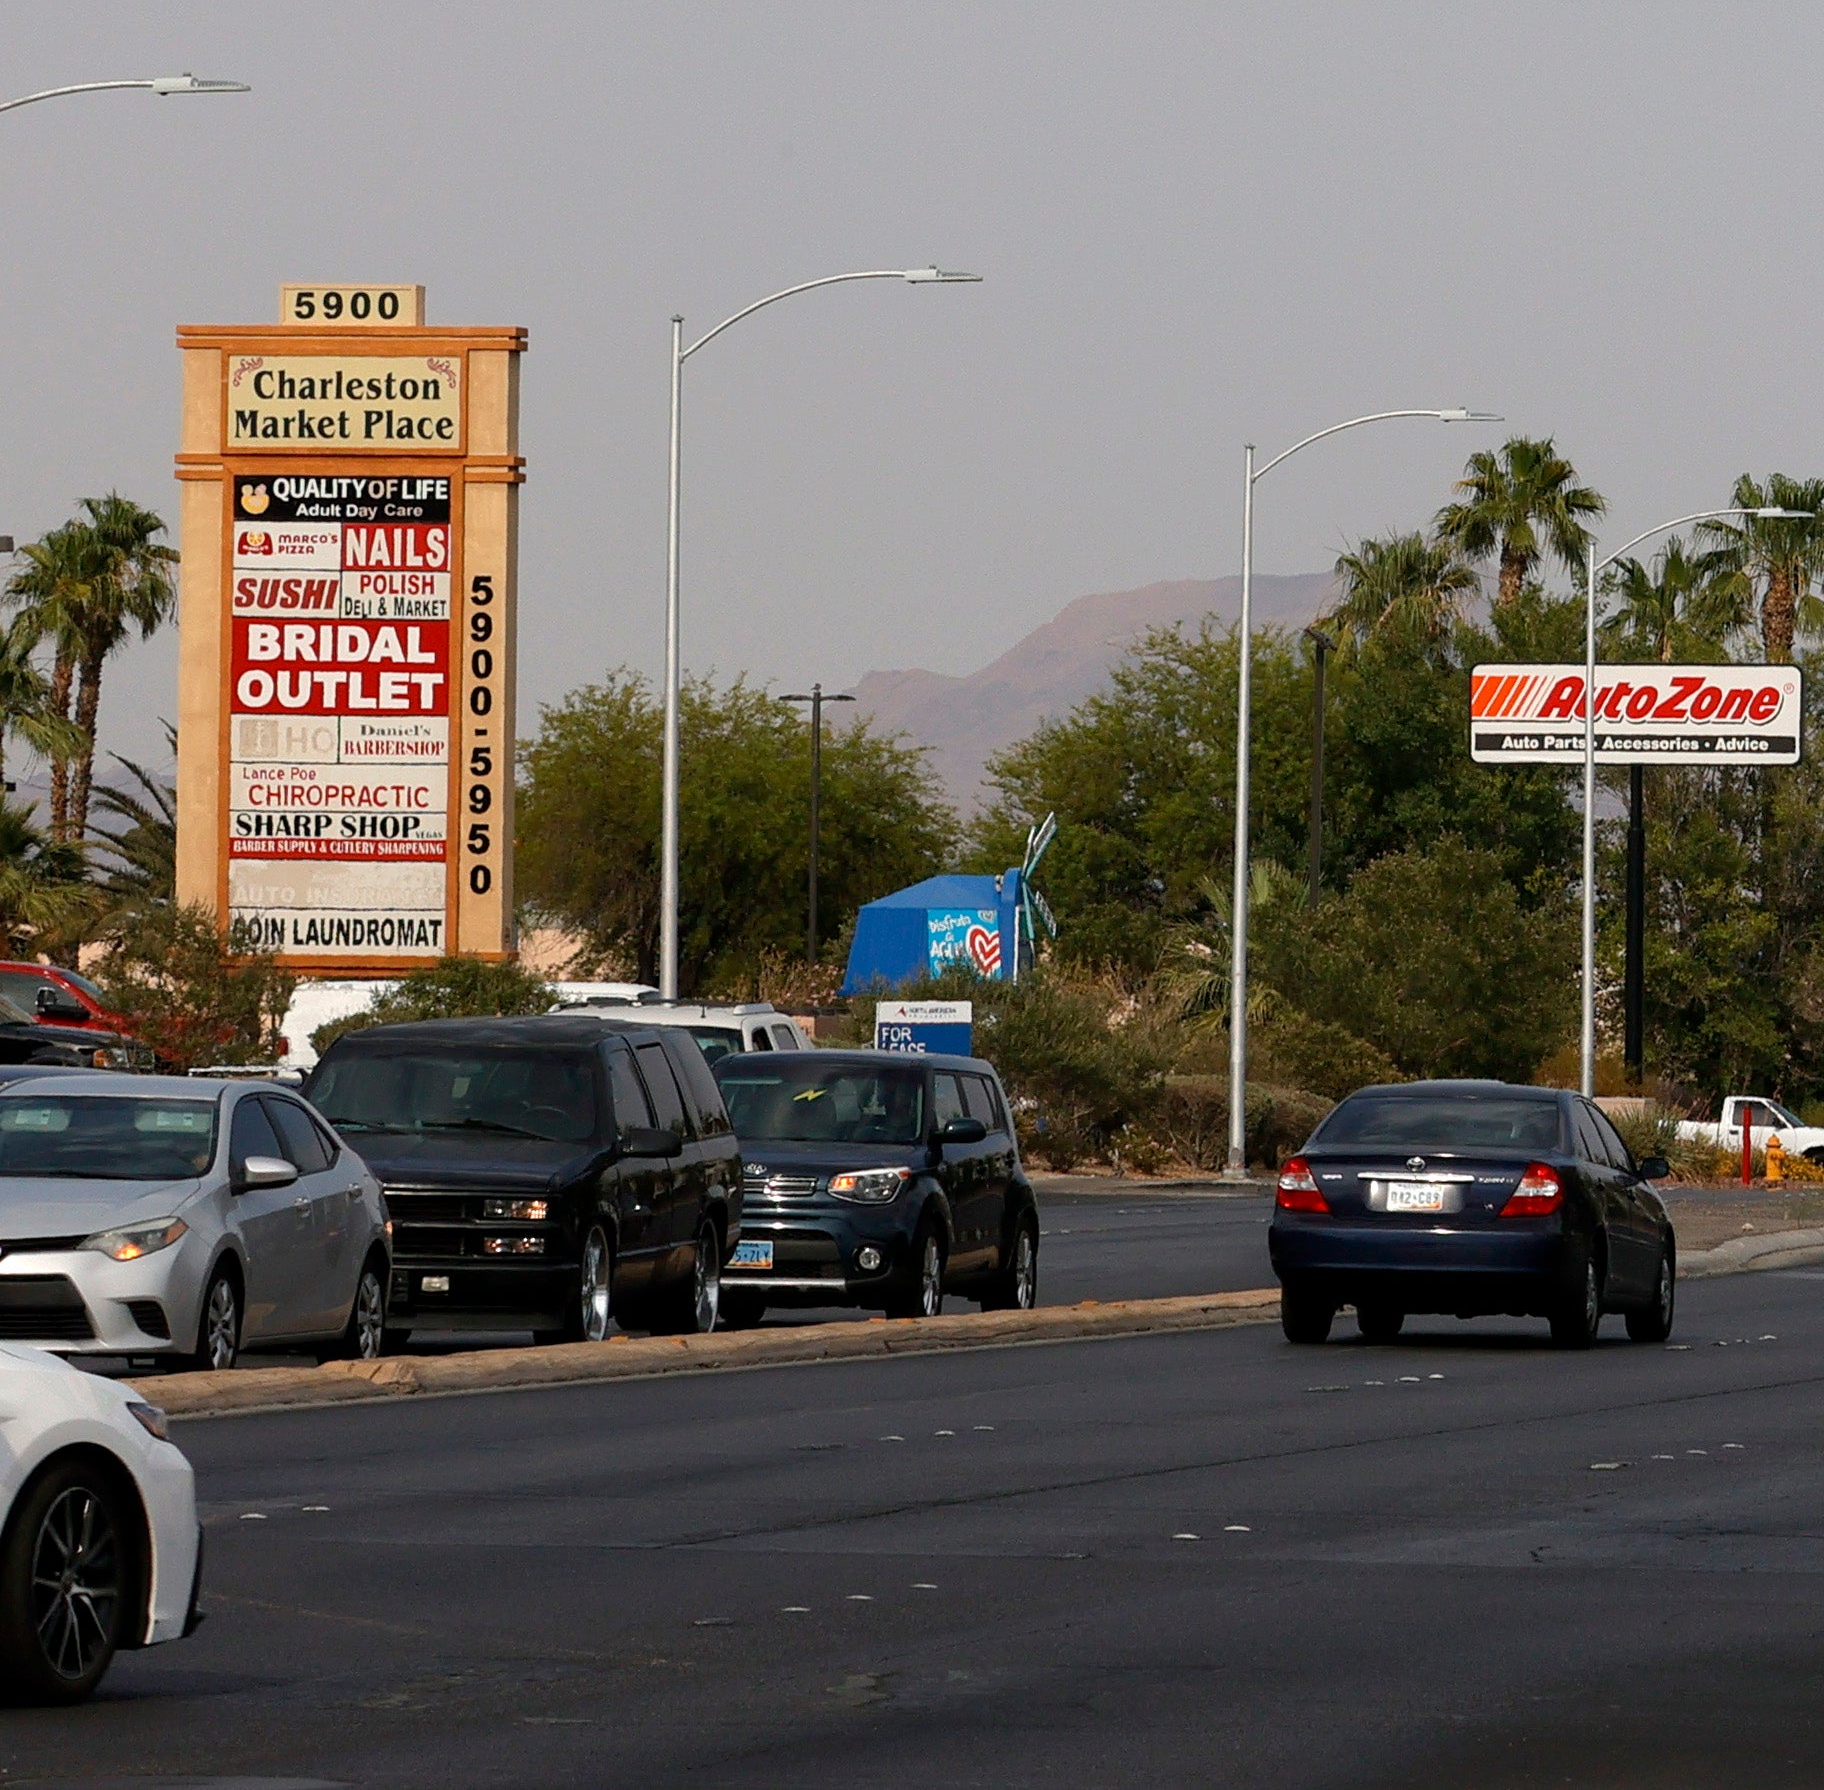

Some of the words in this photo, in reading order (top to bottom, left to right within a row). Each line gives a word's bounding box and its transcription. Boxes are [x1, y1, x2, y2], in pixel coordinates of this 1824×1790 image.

[295, 291, 400, 319] 5900
[253, 370, 441, 400] Charleston
[234, 409, 350, 439] Market
[364, 409, 454, 439] Place
[272, 478, 367, 501] QUALITY
[368, 479, 398, 499] OF
[402, 479, 448, 500] LIFE
[296, 503, 341, 517] Adult
[346, 504, 377, 520] Day
[384, 504, 423, 517] Care
[278, 532, 338, 543] MARCO'S
[346, 527, 445, 567] NAILS
[278, 545, 315, 554] PIZZA
[234, 578, 339, 610] SUSHI
[360, 574, 435, 595] POLISH
[378, 598, 387, 616] &
[248, 624, 435, 664] BRIDAL
[237, 669, 444, 709] OUTLET
[1539, 676, 1781, 721] AutoZone
[360, 724, 431, 736] Daniel's
[467, 575, 493, 895] 5900-5950
[344, 740, 445, 756] BARBERSHOP
[1502, 735, 1540, 750] Auto
[1544, 735, 1587, 750] Parts
[1602, 736, 1699, 751] Accessories
[1715, 737, 1769, 751] Advice
[243, 767, 285, 780] Lance
[290, 767, 316, 780] Poe
[249, 785, 429, 808] CHIROPRACTIC
[236, 813, 332, 837] SHARP
[340, 815, 421, 838] SHOP
[233, 840, 275, 853] BARBER
[277, 841, 316, 853] SUPPLY
[319, 842, 327, 853] &
[330, 842, 375, 855] CUTLERY
[378, 842, 443, 855] SHARPENING
[293, 918, 442, 947] LAUNDROMAT
[882, 1027, 911, 1042] FOR
[882, 1043, 926, 1053] EASE
